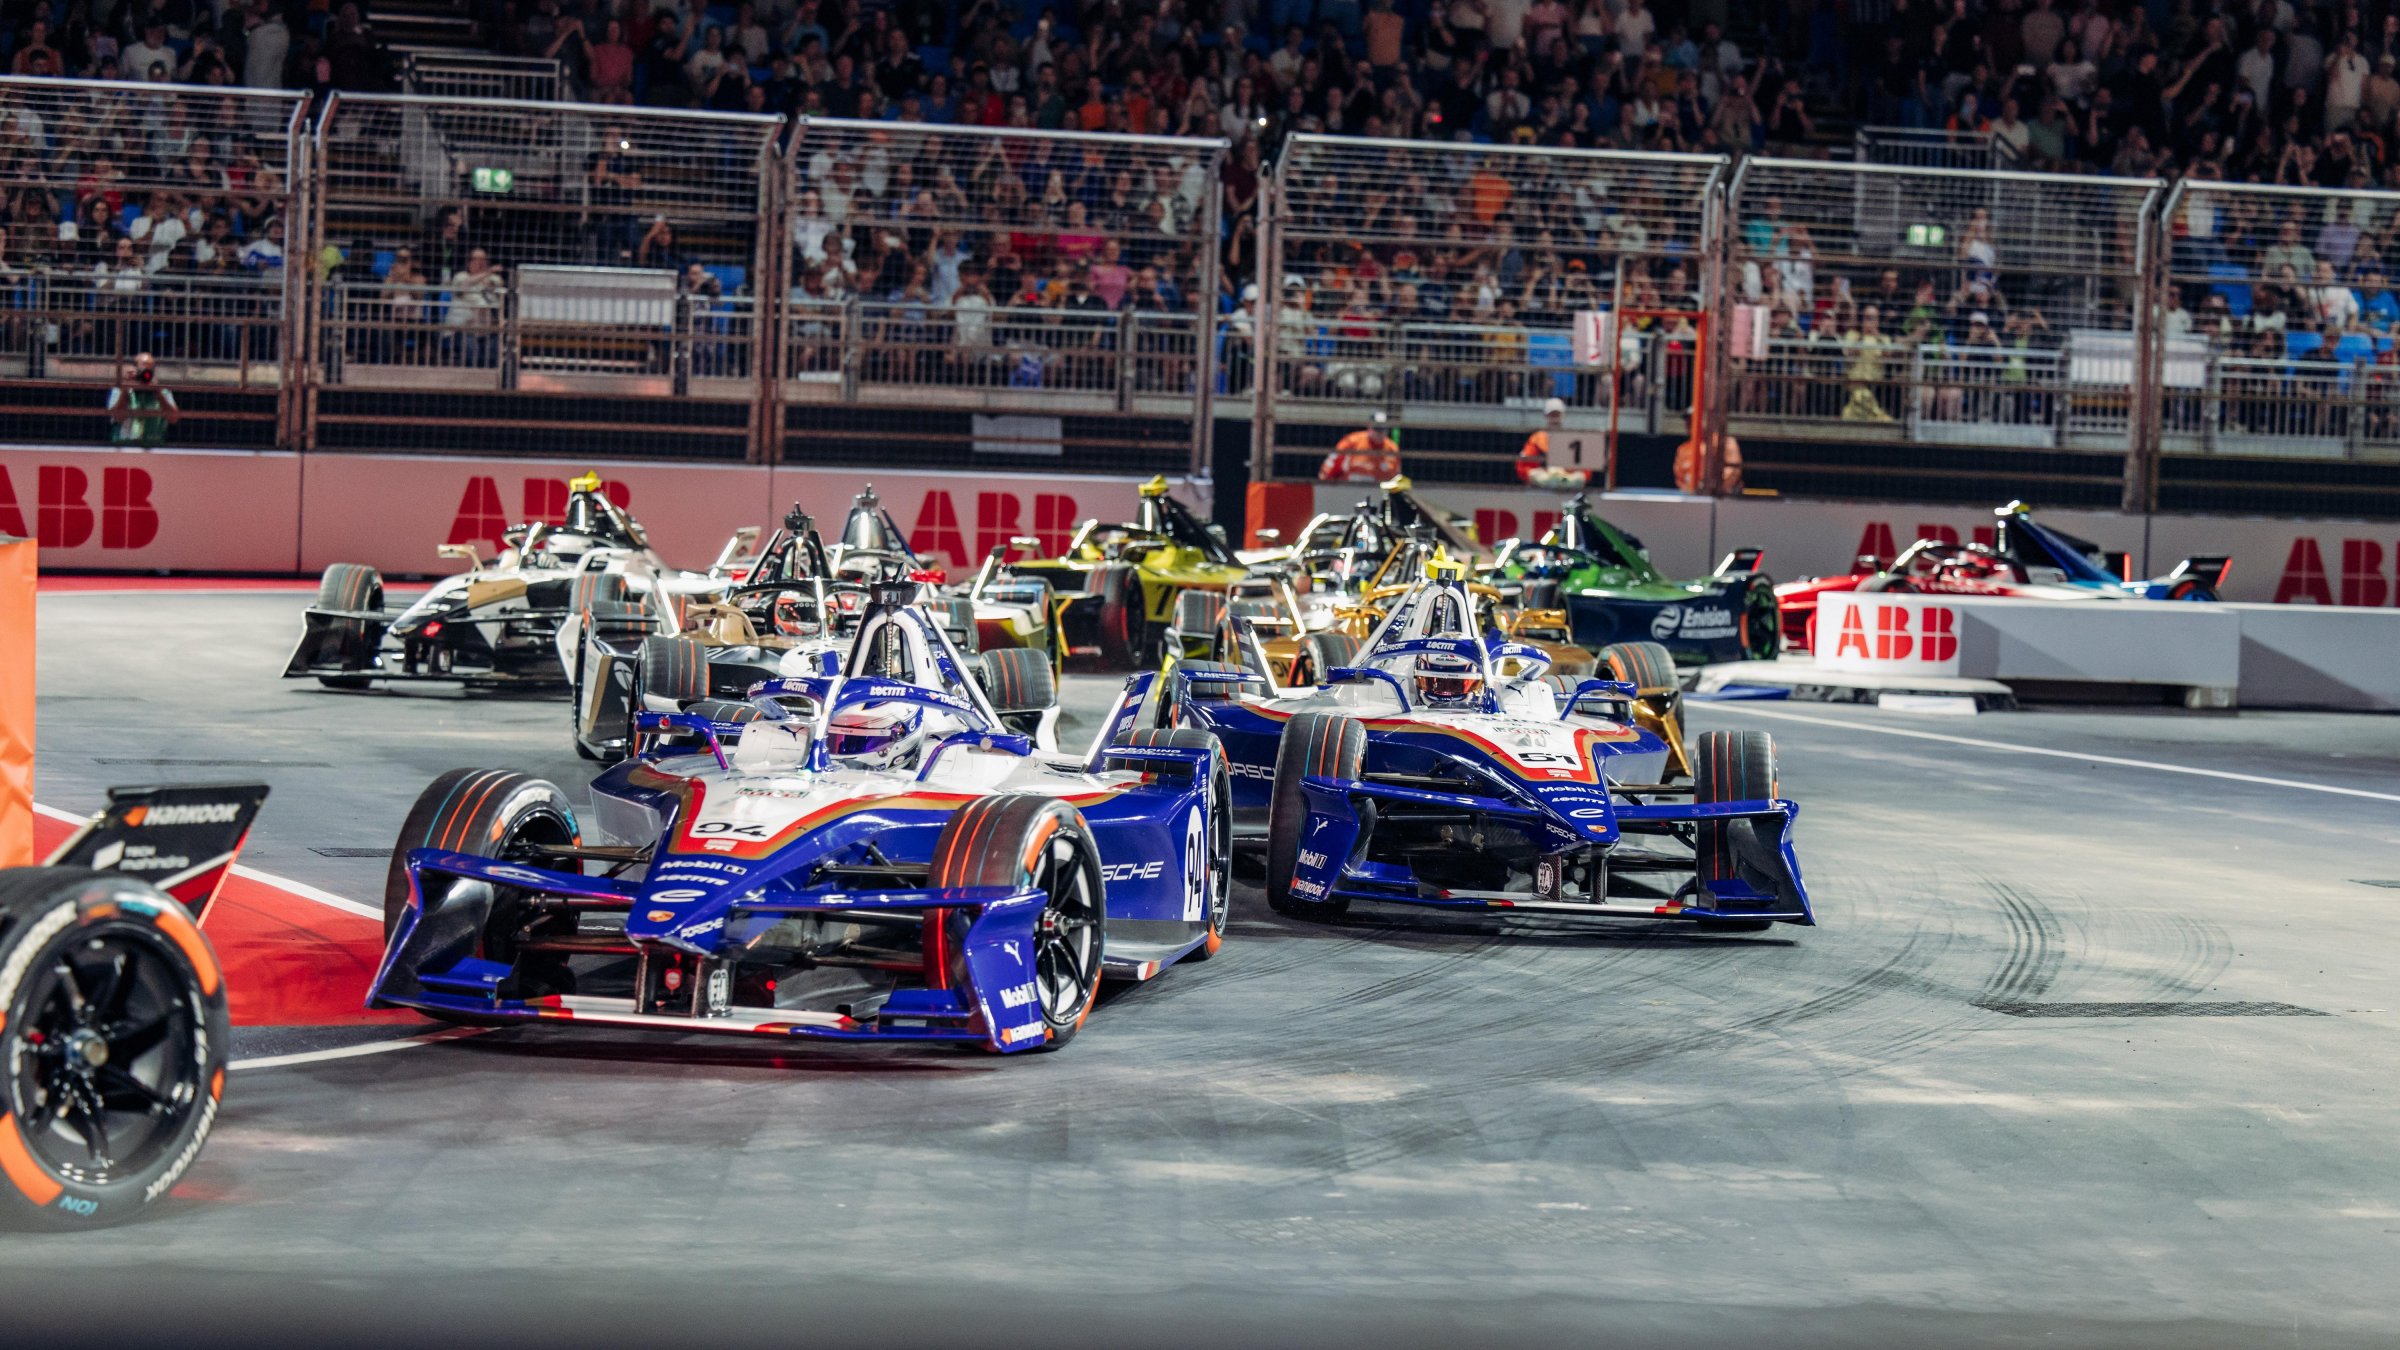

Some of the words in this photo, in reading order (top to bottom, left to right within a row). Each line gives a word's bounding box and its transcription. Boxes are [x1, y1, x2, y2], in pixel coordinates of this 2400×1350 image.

[2272, 537, 2400, 607] AB
[1836, 604, 1958, 662] ABB
[1426, 641, 1456, 650] LOCTITE
[870, 686, 906, 696] LOCTITE
[1518, 753, 1576, 765] 51
[695, 822, 767, 837] 94
[1546, 823, 1577, 842] PORSCHE
[660, 861, 722, 870] Mobil
[1299, 848, 1319, 867] Mobil
[1101, 861, 1164, 881] SCHE
[1187, 831, 1202, 913] 94
[680, 917, 724, 938] PORSCHE
[1000, 983, 1029, 1009] Mobil
